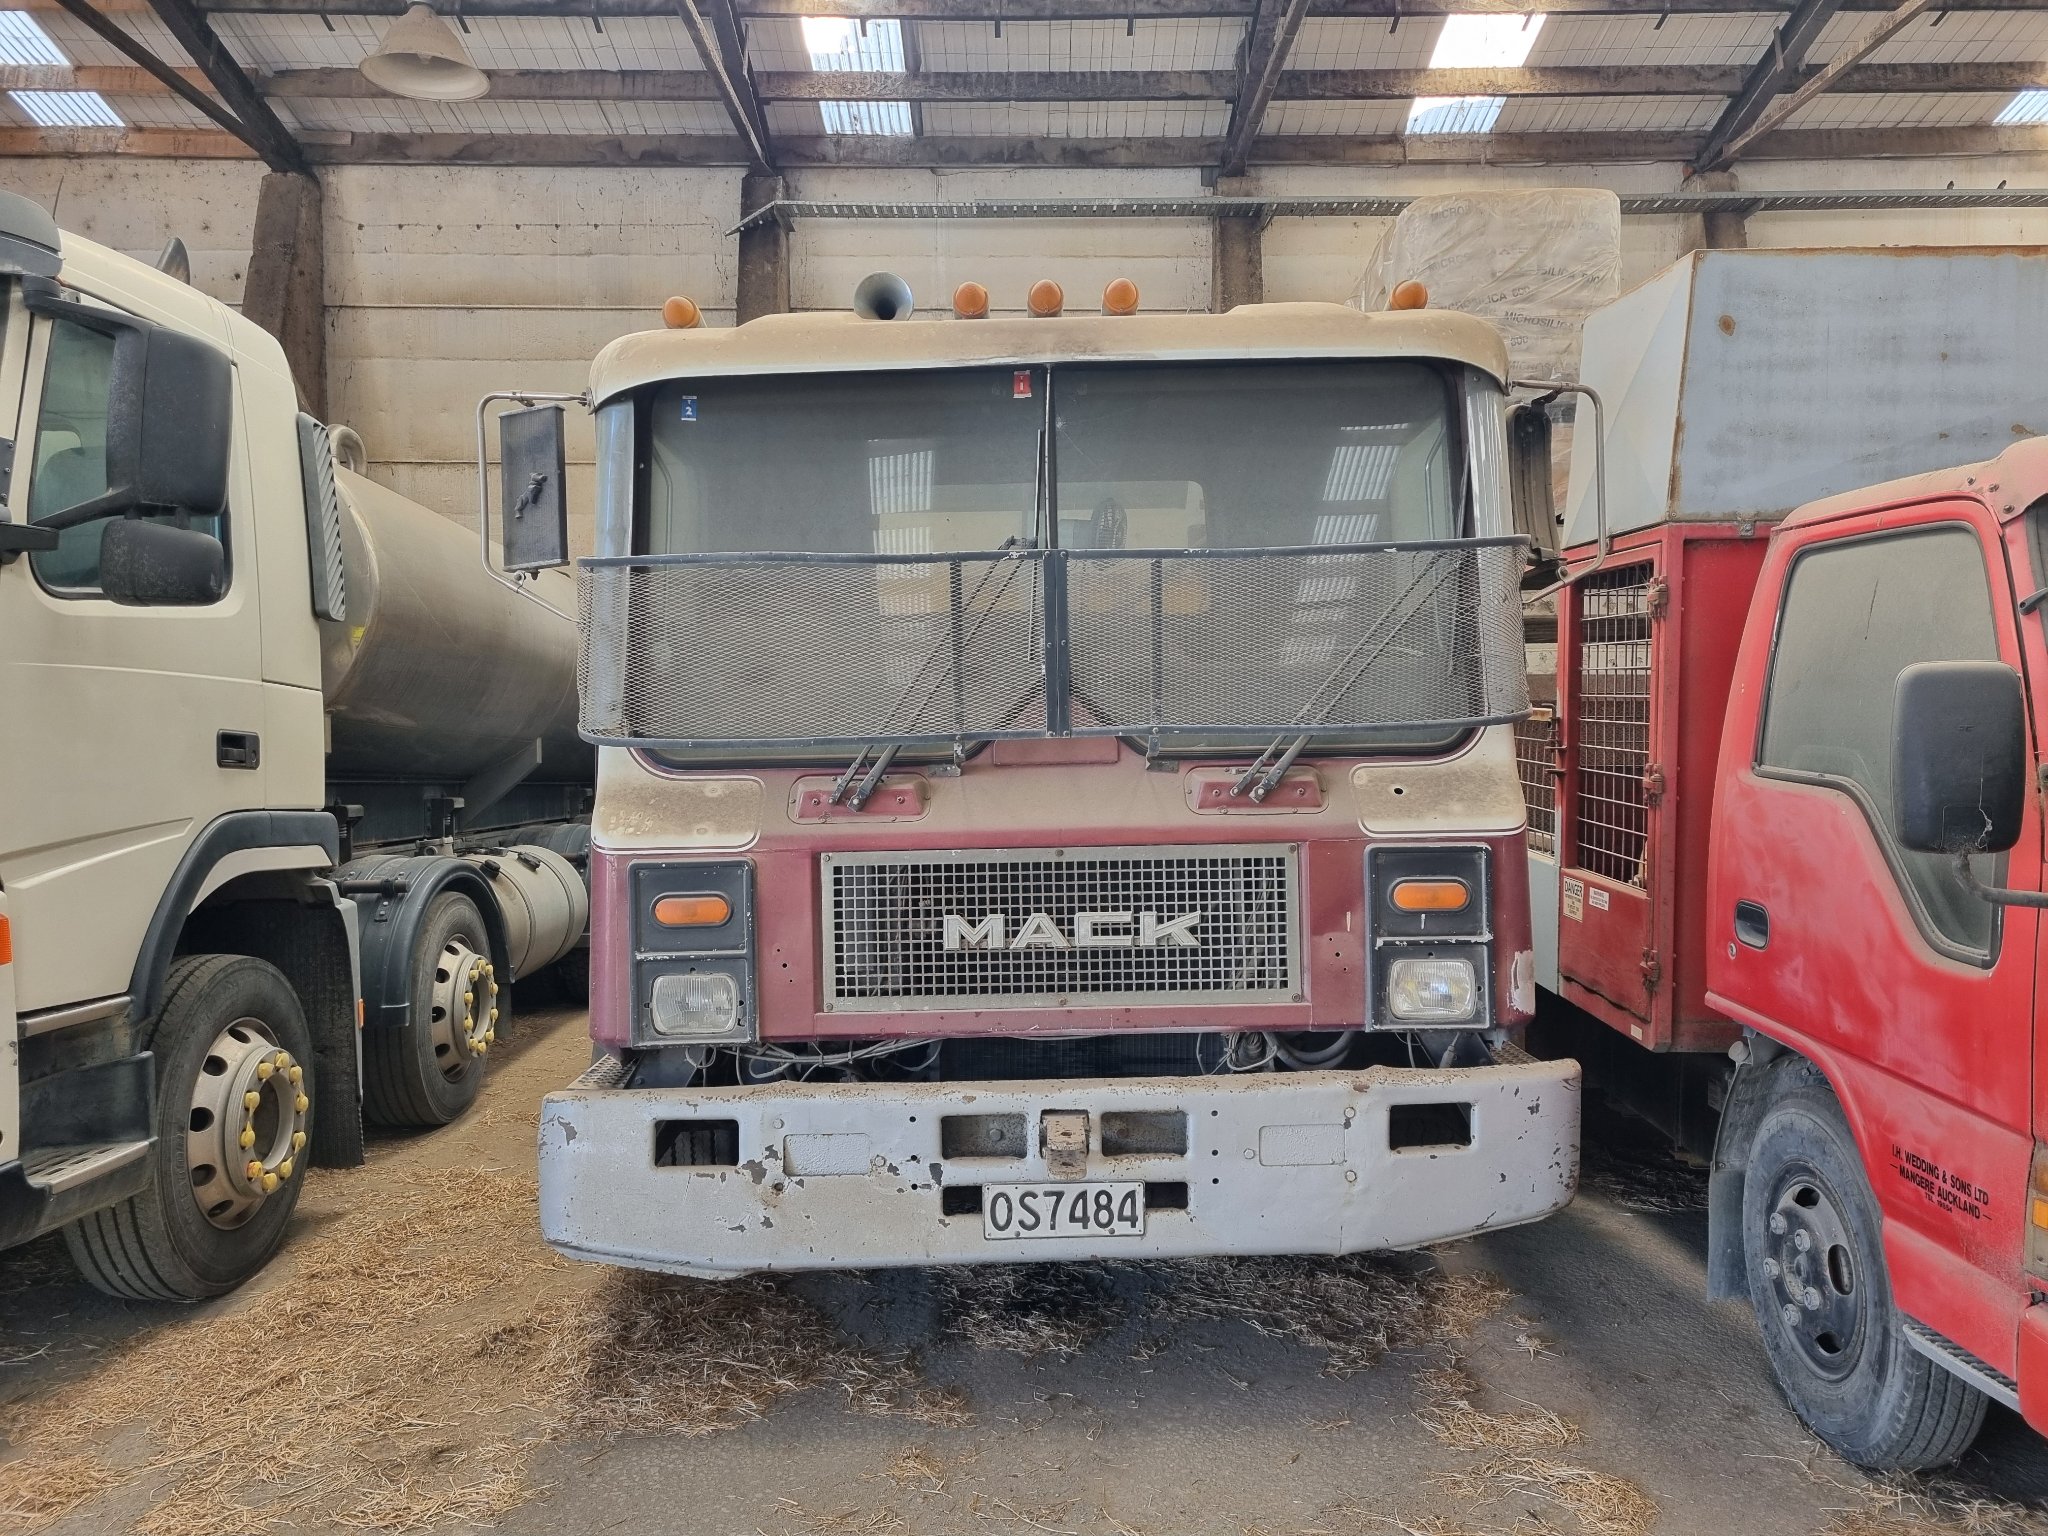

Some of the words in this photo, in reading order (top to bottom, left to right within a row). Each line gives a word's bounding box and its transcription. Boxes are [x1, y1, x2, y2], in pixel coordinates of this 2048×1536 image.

[685, 406, 693, 415] 2
[1565, 881, 1583, 897] DANGER
[943, 910, 1201, 950] MACK
[1899, 1164, 1935, 1195] MANGERE
[1937, 1185, 1981, 1219] AUCKLAND
[1904, 1150, 1940, 1179] WEDDING
[1941, 1169, 1948, 1184] &
[1950, 1174, 1972, 1198] SONS
[1974, 1186, 1989, 1206] LTD
[989, 1188, 1140, 1232] OS7484
